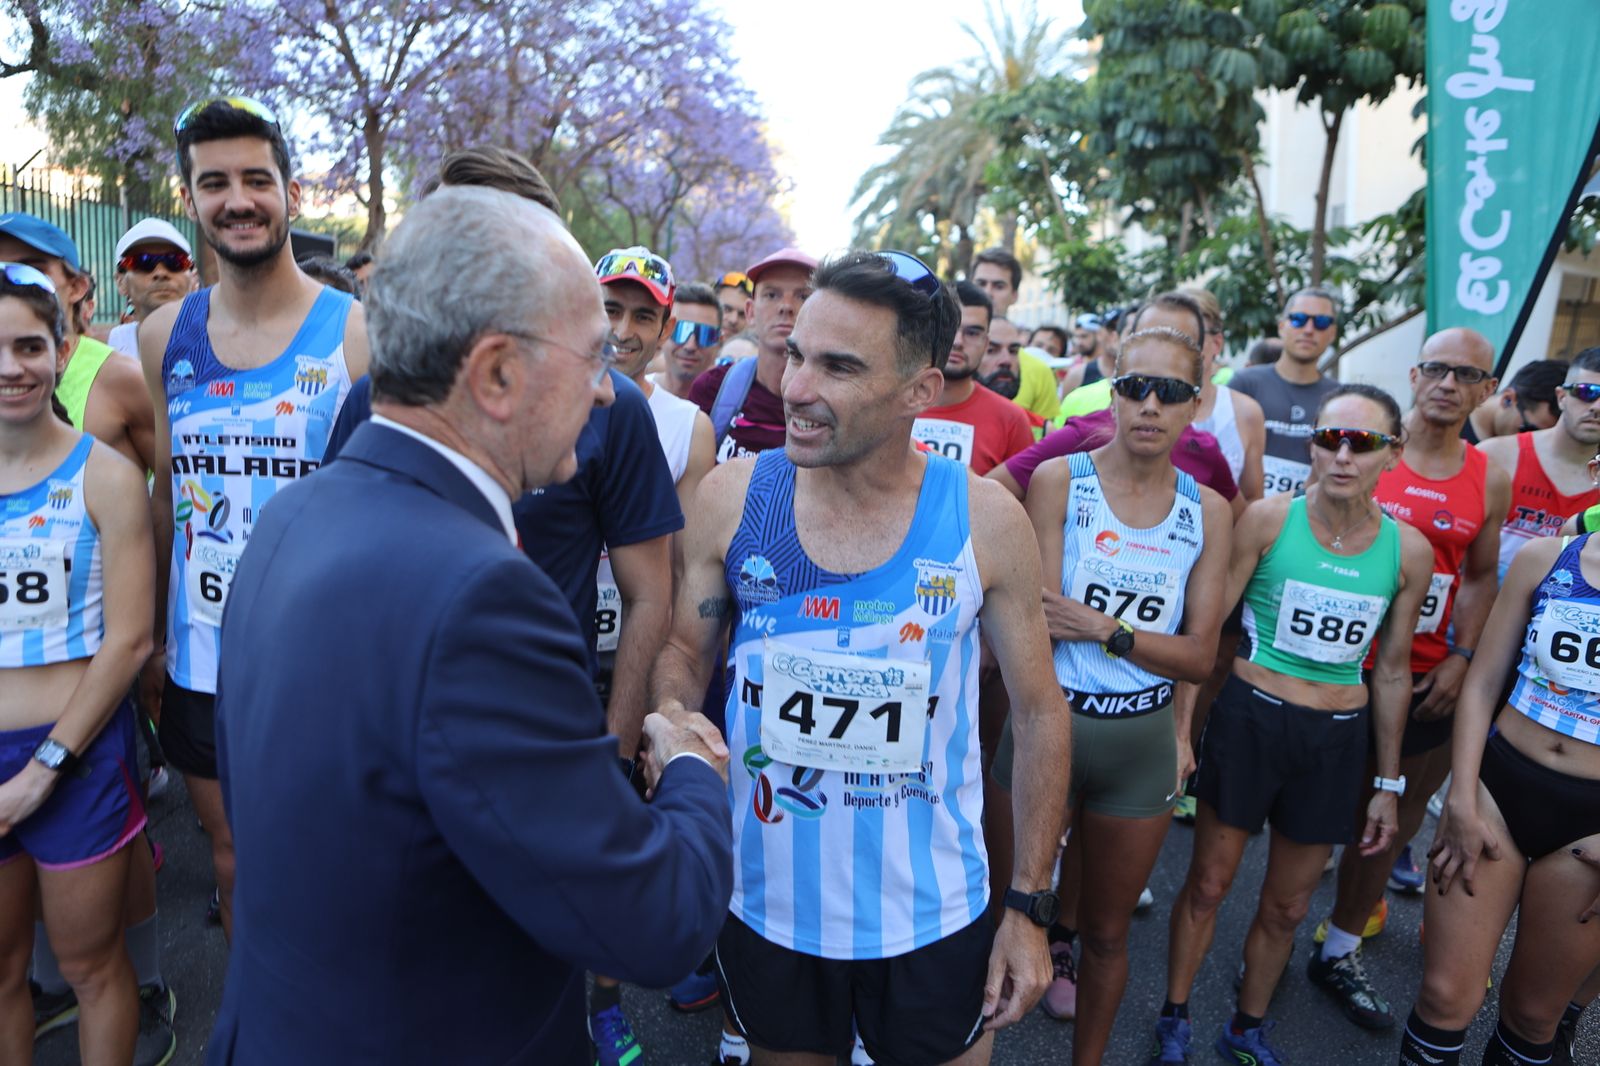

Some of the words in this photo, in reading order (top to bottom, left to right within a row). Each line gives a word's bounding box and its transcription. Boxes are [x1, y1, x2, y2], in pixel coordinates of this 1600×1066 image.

[854, 600, 896, 612] metro
[1084, 582, 1166, 623] 676
[1290, 607, 1367, 646] 586
[1081, 690, 1154, 714] NIKE
[779, 690, 902, 743] 471
[1558, 708, 1588, 722] CAPITAL
[844, 791, 891, 811] Deporte
[894, 792, 899, 808] y
